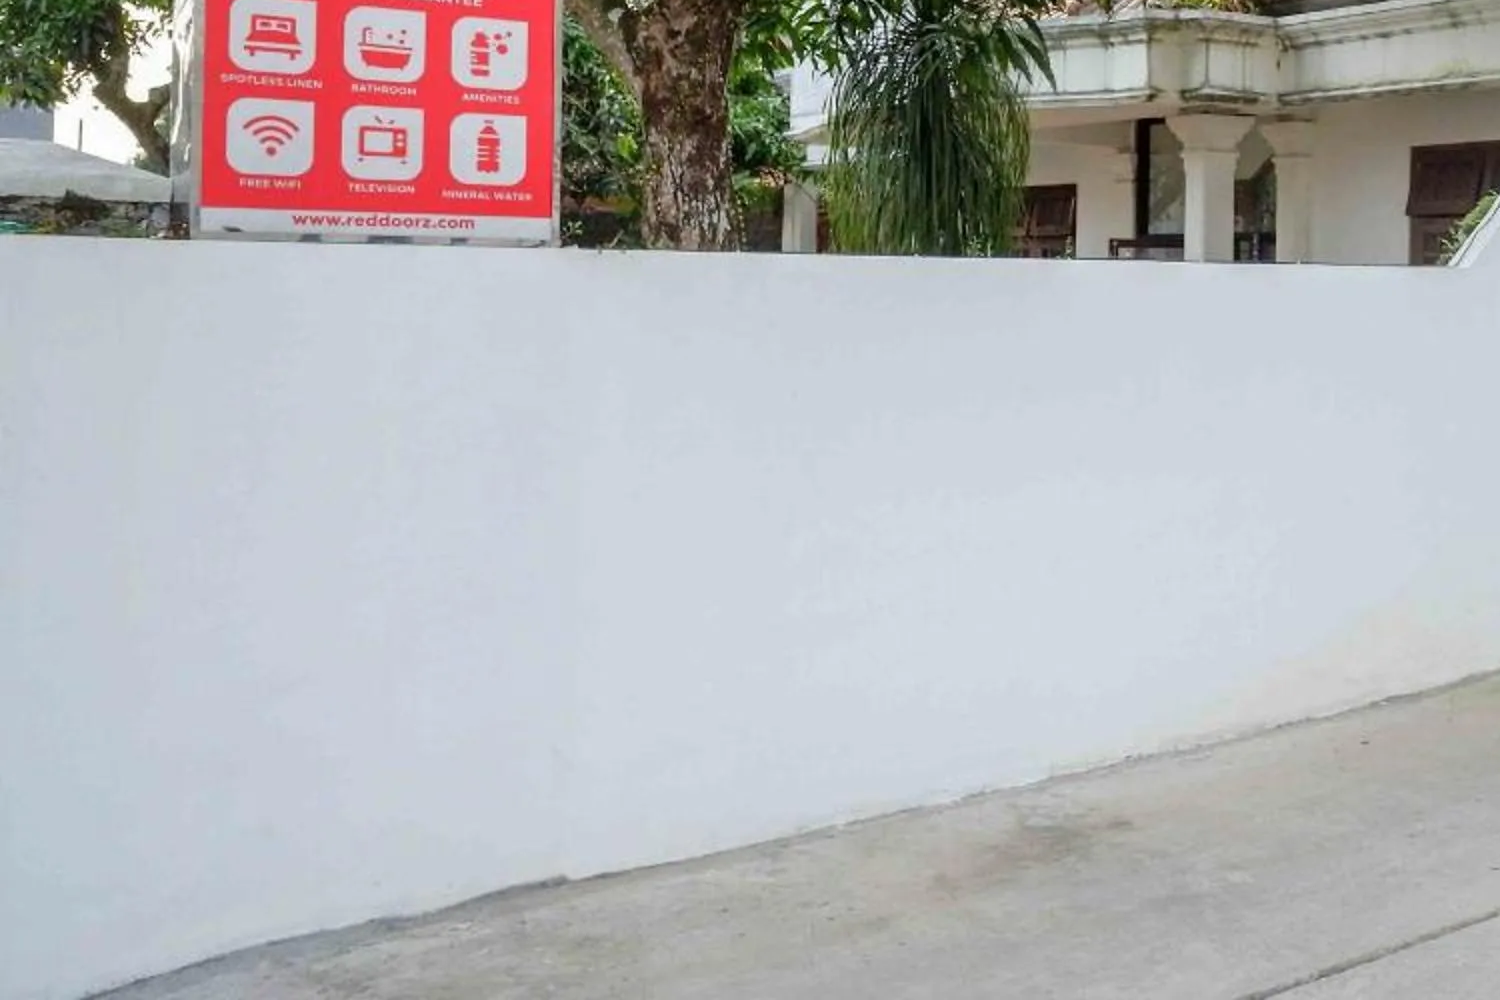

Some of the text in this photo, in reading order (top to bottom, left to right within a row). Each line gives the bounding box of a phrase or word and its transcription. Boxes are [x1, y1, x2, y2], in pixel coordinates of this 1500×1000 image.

[287, 77, 324, 89] LINEN
[350, 83, 418, 96] BATHROOM
[461, 93, 521, 105] AMENITIES
[238, 177, 272, 189] FREE
[347, 183, 416, 195] TELEVISION
[493, 191, 534, 203] WATER
[291, 212, 476, 231] www.reddoorz.com
